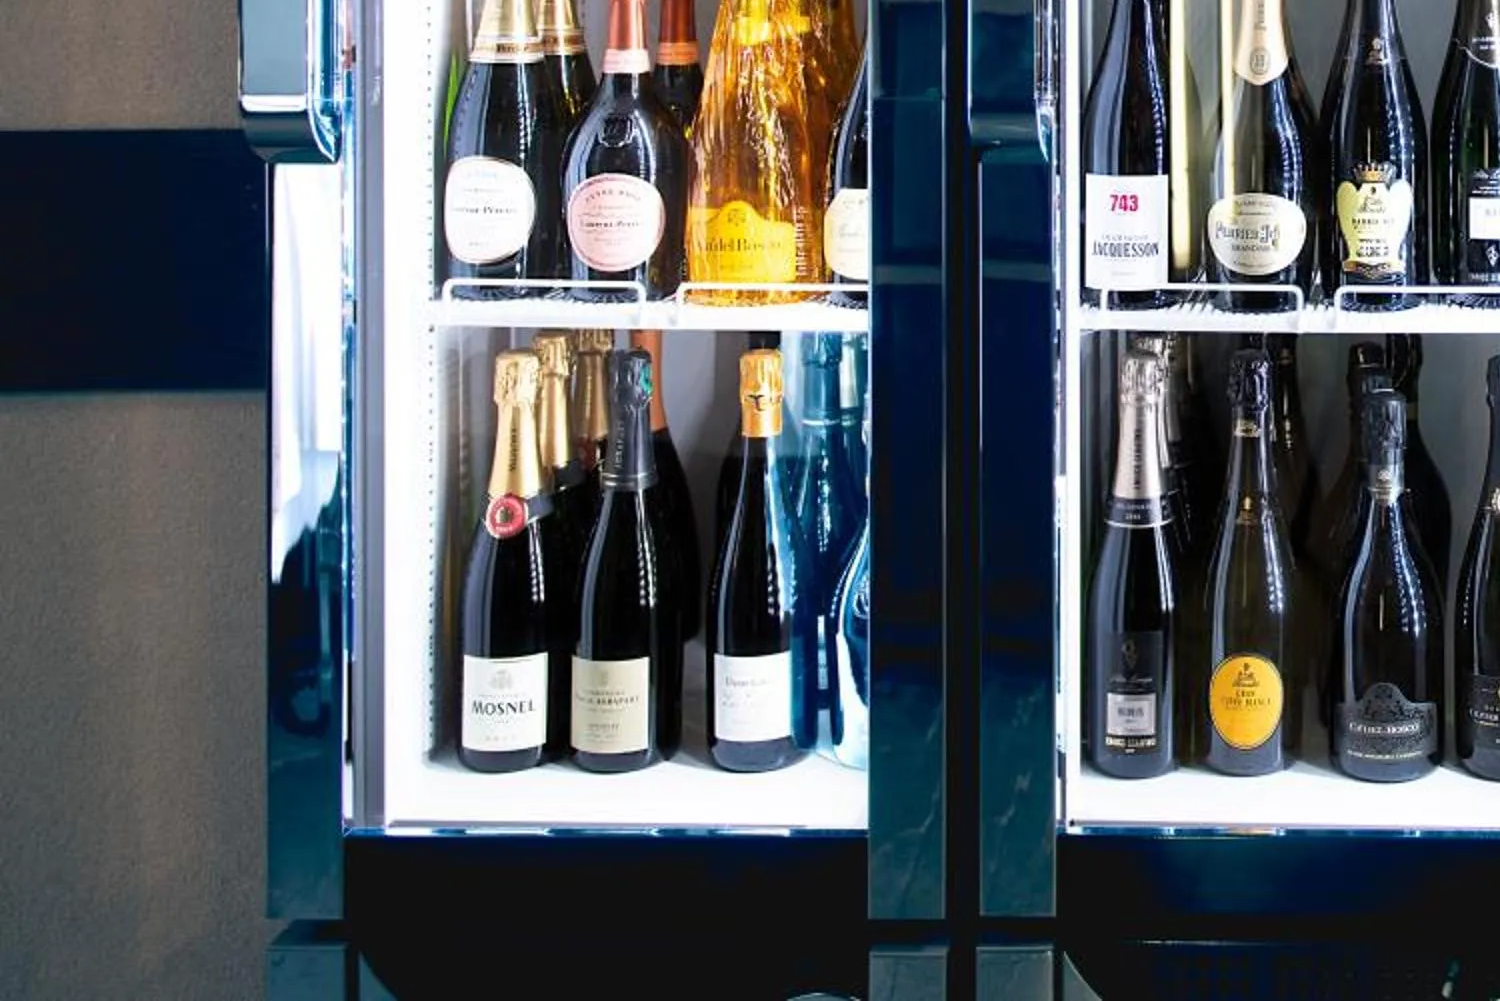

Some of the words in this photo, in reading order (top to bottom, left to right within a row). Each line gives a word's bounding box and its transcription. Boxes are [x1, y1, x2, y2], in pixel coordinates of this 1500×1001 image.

[1110, 194, 1139, 212] 743
[1092, 240, 1159, 258] JACQUESSON
[472, 699, 537, 716] MOSNEL
